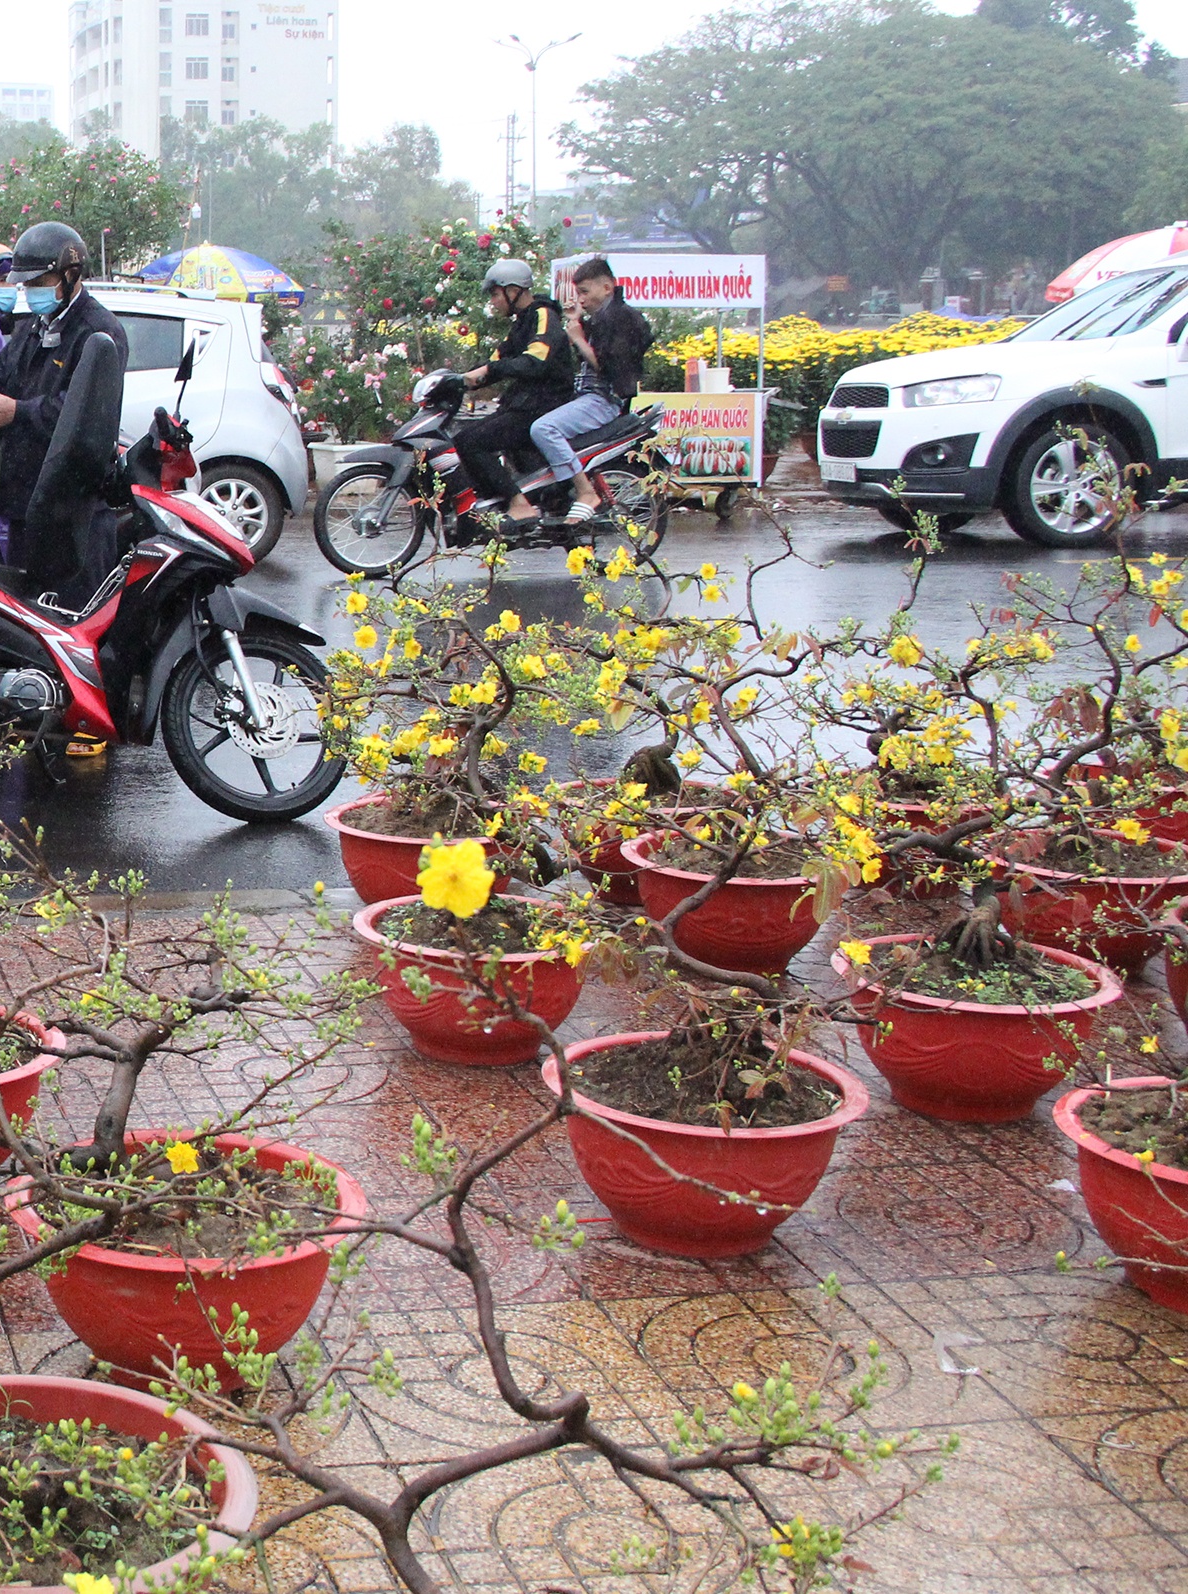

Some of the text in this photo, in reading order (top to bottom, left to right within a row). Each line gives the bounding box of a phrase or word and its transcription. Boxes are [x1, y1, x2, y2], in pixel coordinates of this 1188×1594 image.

[266, 15, 318, 26] Liên hoan
[285, 28, 324, 40] Sự kiện
[651, 269, 695, 300] PHÔMAI
[697, 269, 720, 299] HÀN
[722, 263, 752, 303] QUỐC
[679, 400, 699, 429] PHỐ
[701, 403, 721, 429] HÀN
[722, 399, 748, 430] QUỐC
[137, 549, 163, 558] HONDA
